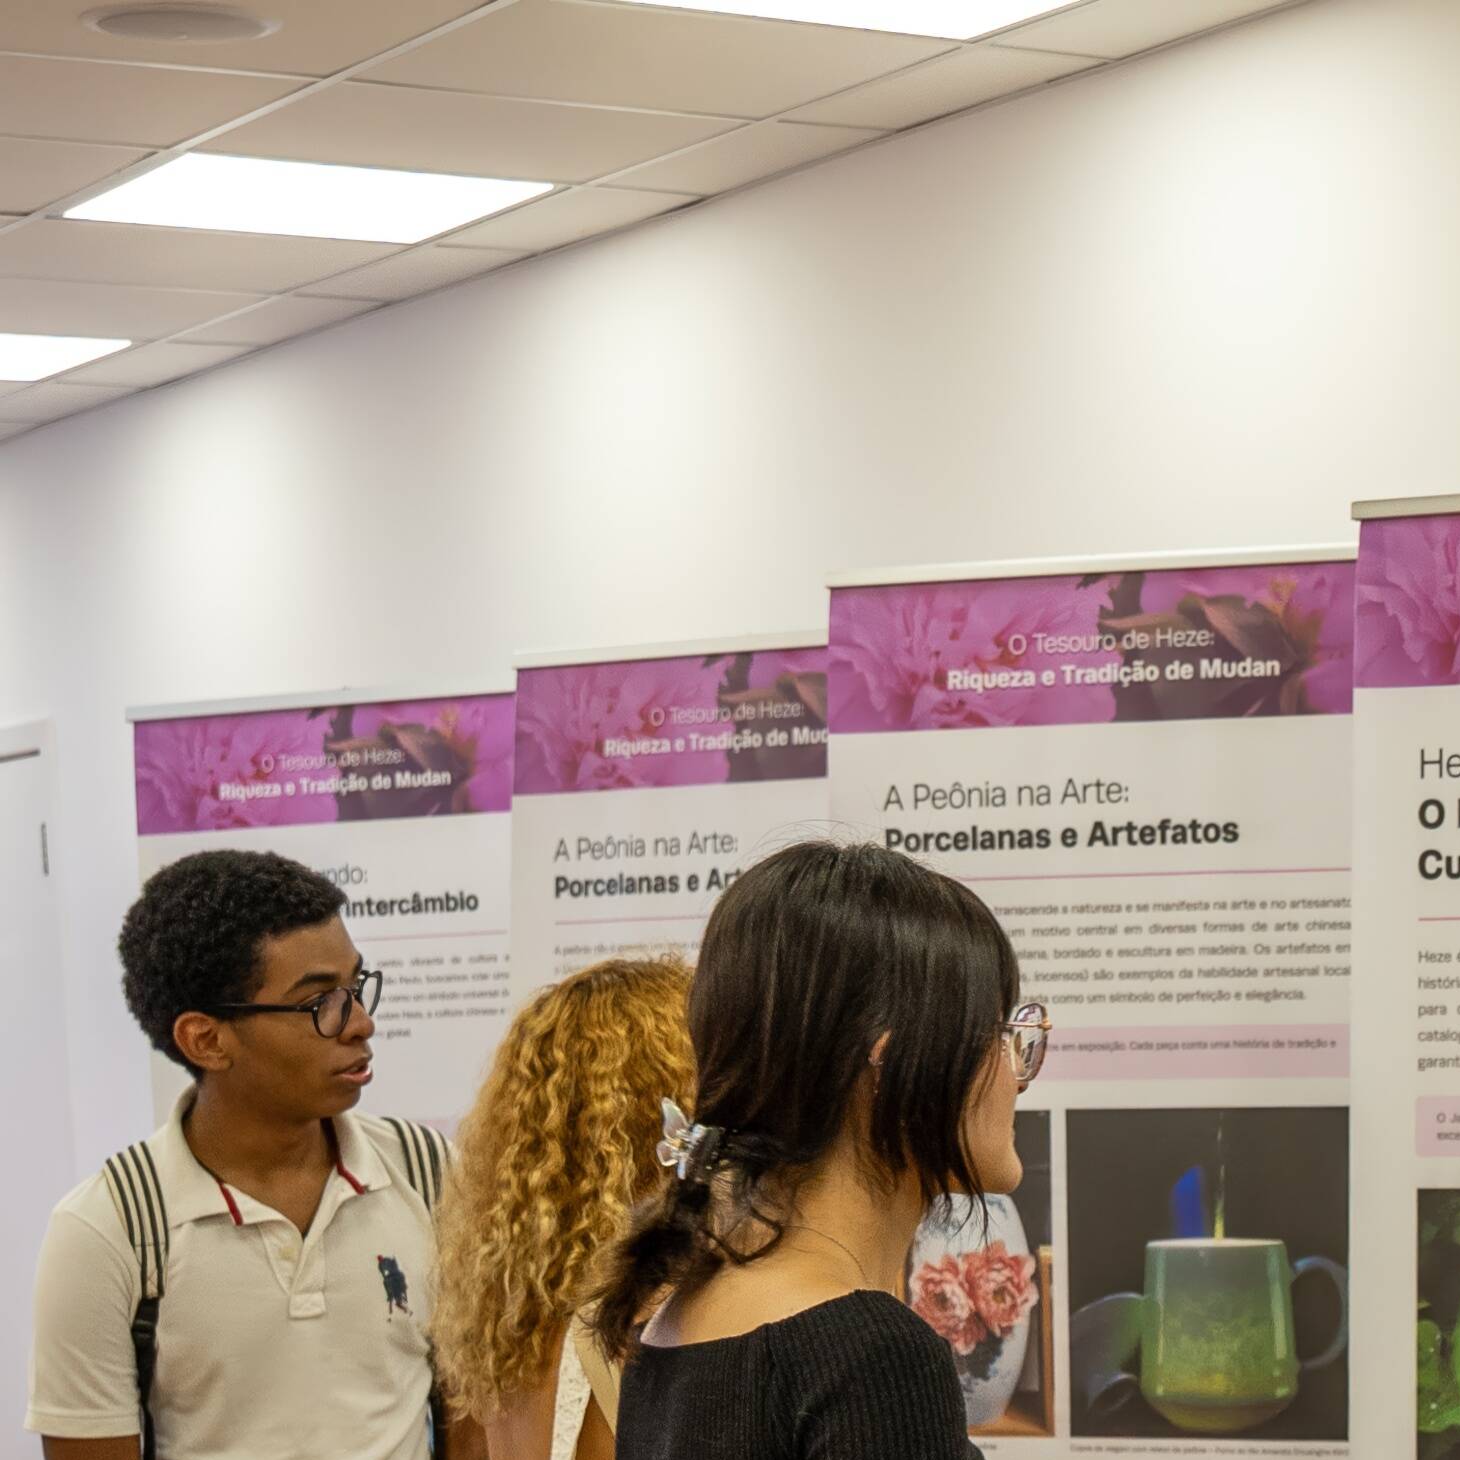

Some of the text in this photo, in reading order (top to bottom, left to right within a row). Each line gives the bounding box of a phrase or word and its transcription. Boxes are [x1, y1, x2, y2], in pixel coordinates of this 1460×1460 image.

[1009, 628, 1214, 656] O Tesouro de Heze:
[947, 658, 1280, 693] Riqueza e Tradição de Mudan
[651, 703, 804, 726] O Tesouro de Heze:
[262, 748, 405, 772] O Tesouro de Heze:
[605, 740, 670, 758] Riqueza
[675, 741, 684, 753] e
[690, 730, 761, 753] Tradição
[766, 729, 787, 747] de
[220, 770, 451, 803] Riqueza e Tradição de Mudan
[882, 777, 1129, 812] A Peônia na Arte:
[1417, 797, 1445, 830] O
[552, 829, 738, 862] A Peônia na Arte:
[884, 817, 1239, 854] Porcelanas e Artefatos
[554, 872, 680, 899] Porcelanas
[685, 872, 700, 893] e
